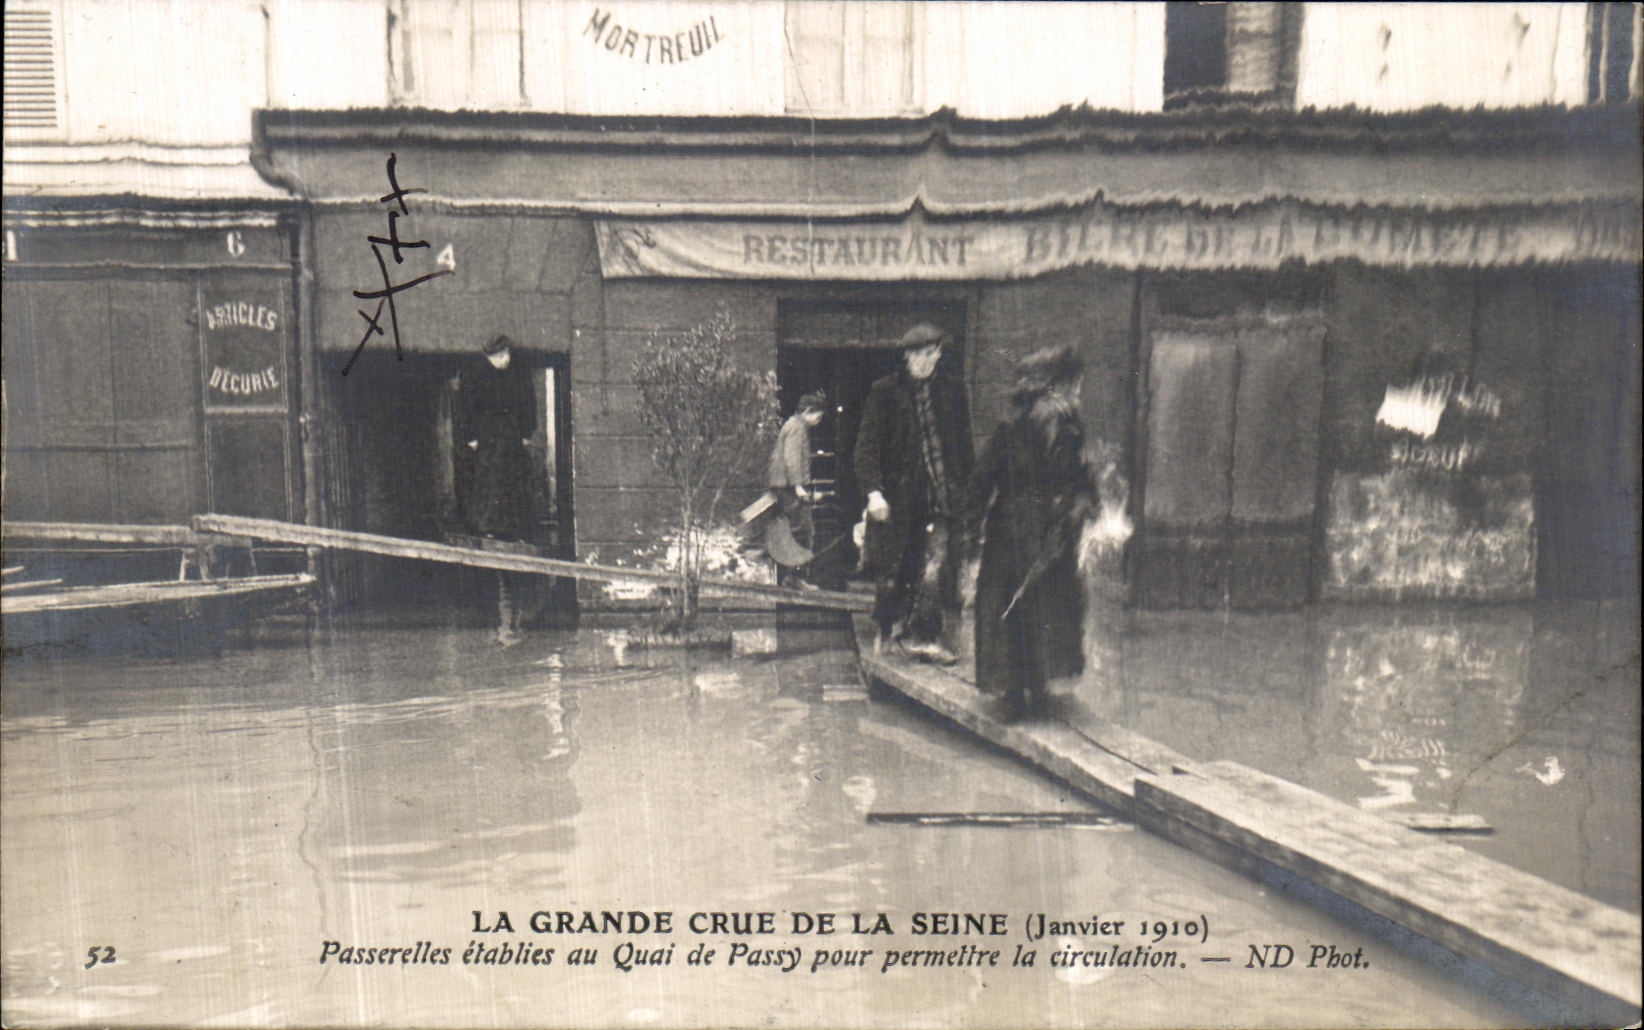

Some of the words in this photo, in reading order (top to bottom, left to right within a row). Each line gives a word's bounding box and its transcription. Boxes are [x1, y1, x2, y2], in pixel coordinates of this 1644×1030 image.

[582, 6, 723, 65] MORTREUIL
[226, 230, 246, 258] 6
[437, 243, 456, 271] 4
[743, 234, 975, 268] RESTAURANT
[205, 301, 278, 331] ARTICLES
